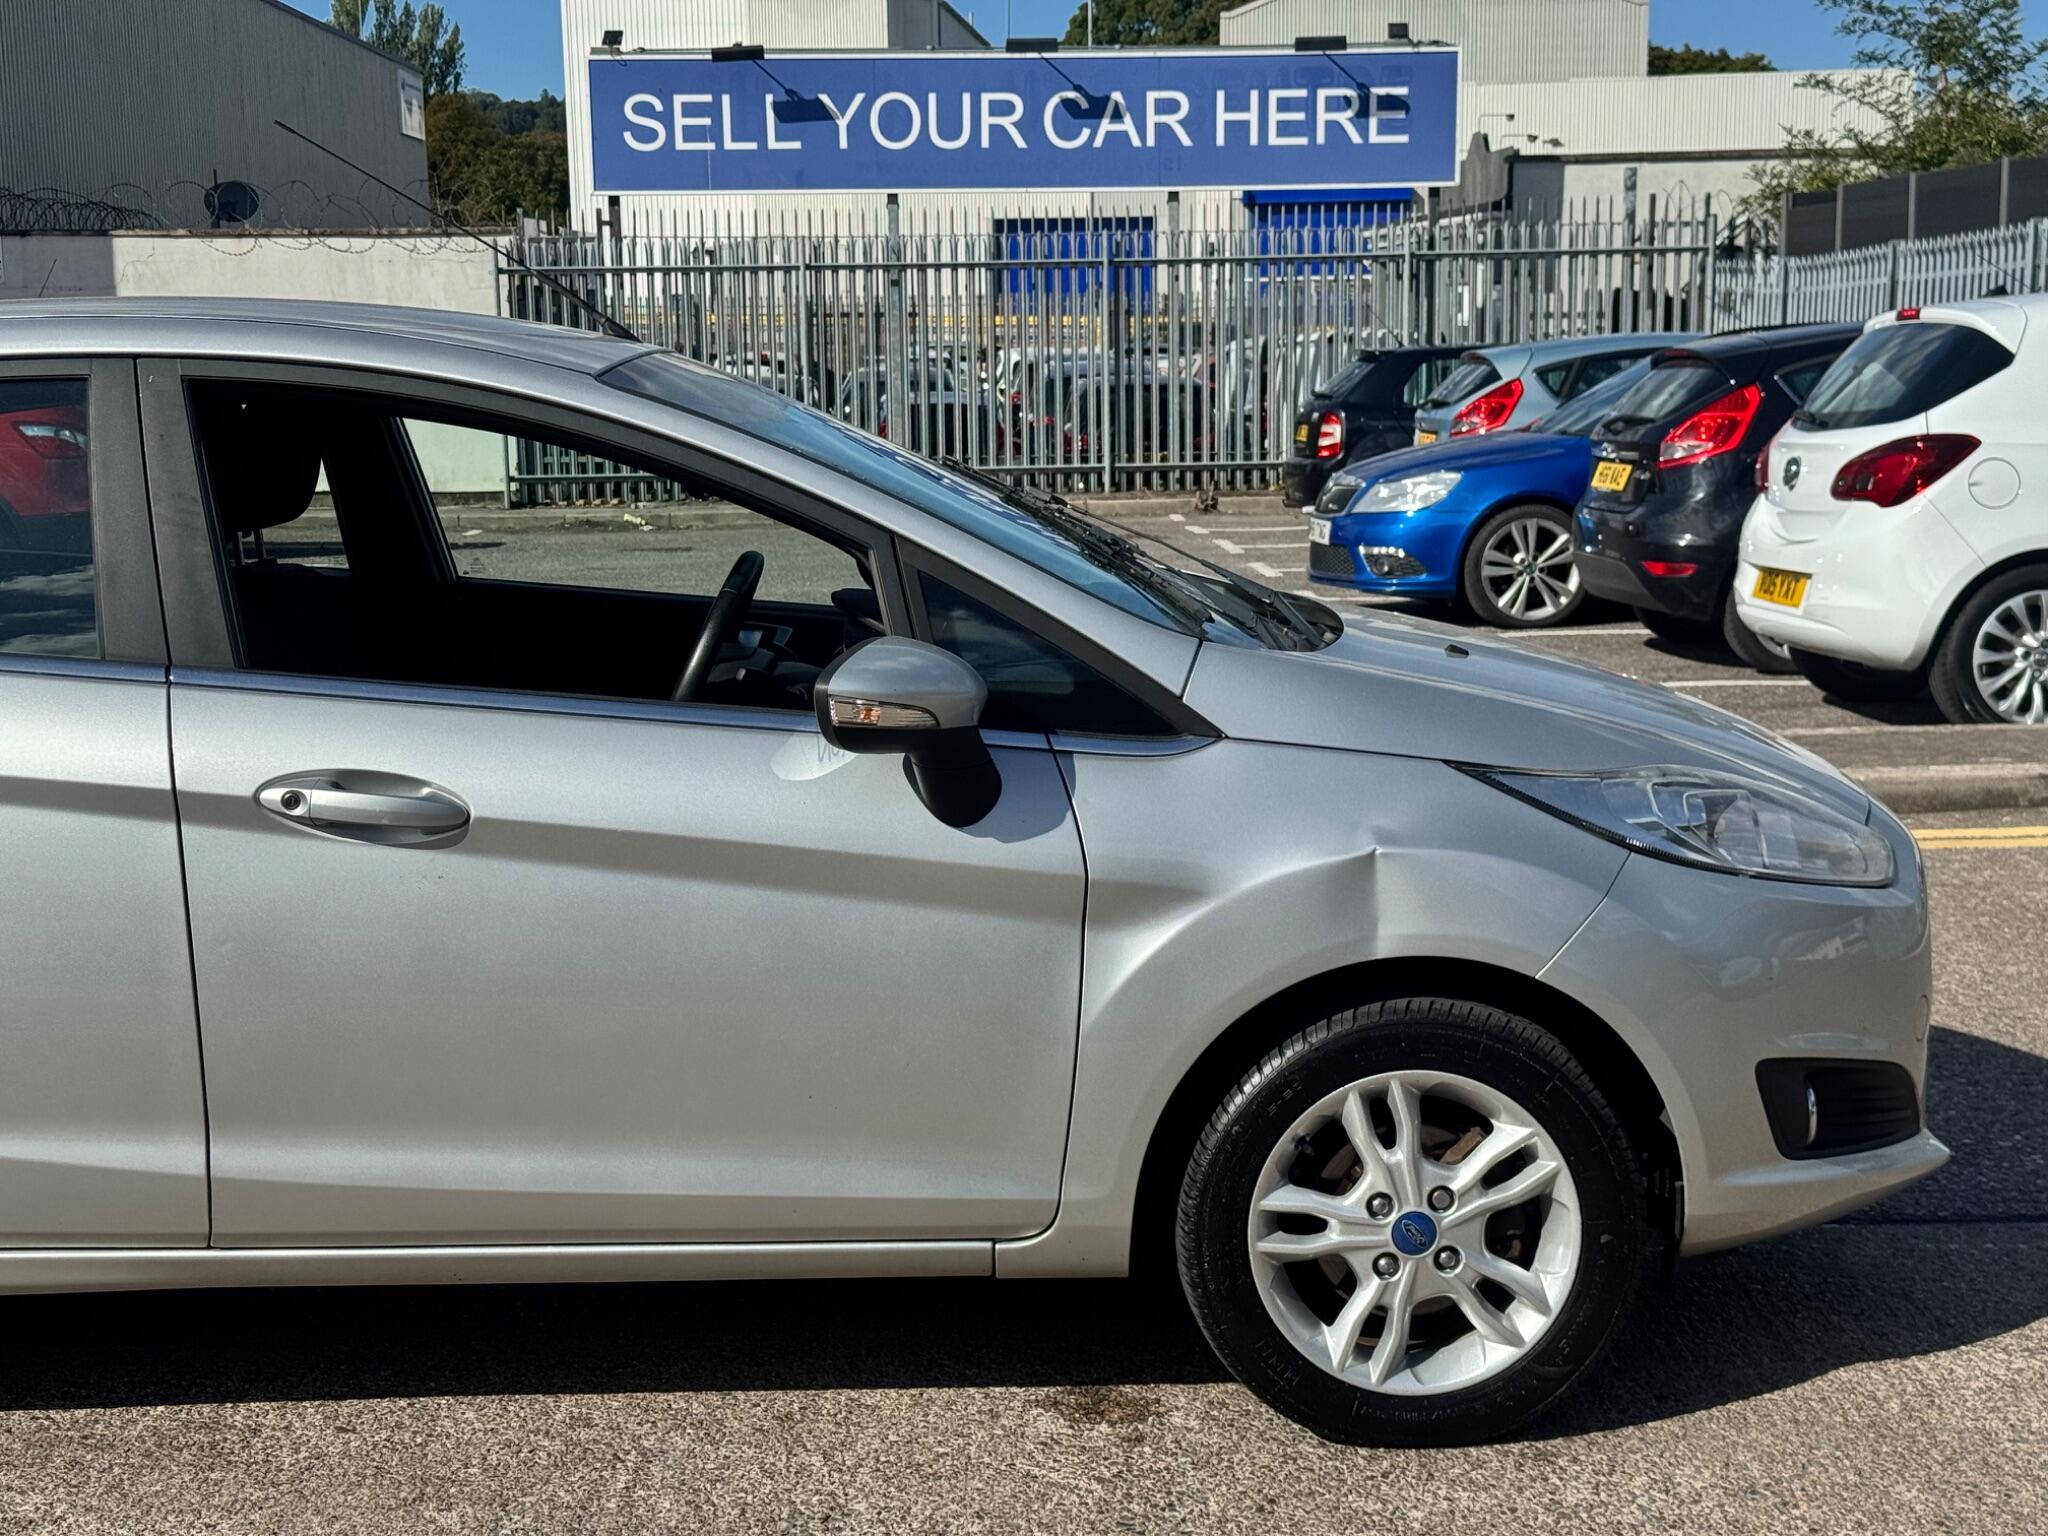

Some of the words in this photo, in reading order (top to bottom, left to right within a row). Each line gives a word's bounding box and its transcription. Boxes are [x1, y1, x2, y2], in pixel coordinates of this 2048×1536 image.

[623, 93, 802, 151] SELL
[816, 91, 1028, 150] YOUR
[1043, 90, 1193, 148] CAR
[1215, 86, 1410, 147] HERE
